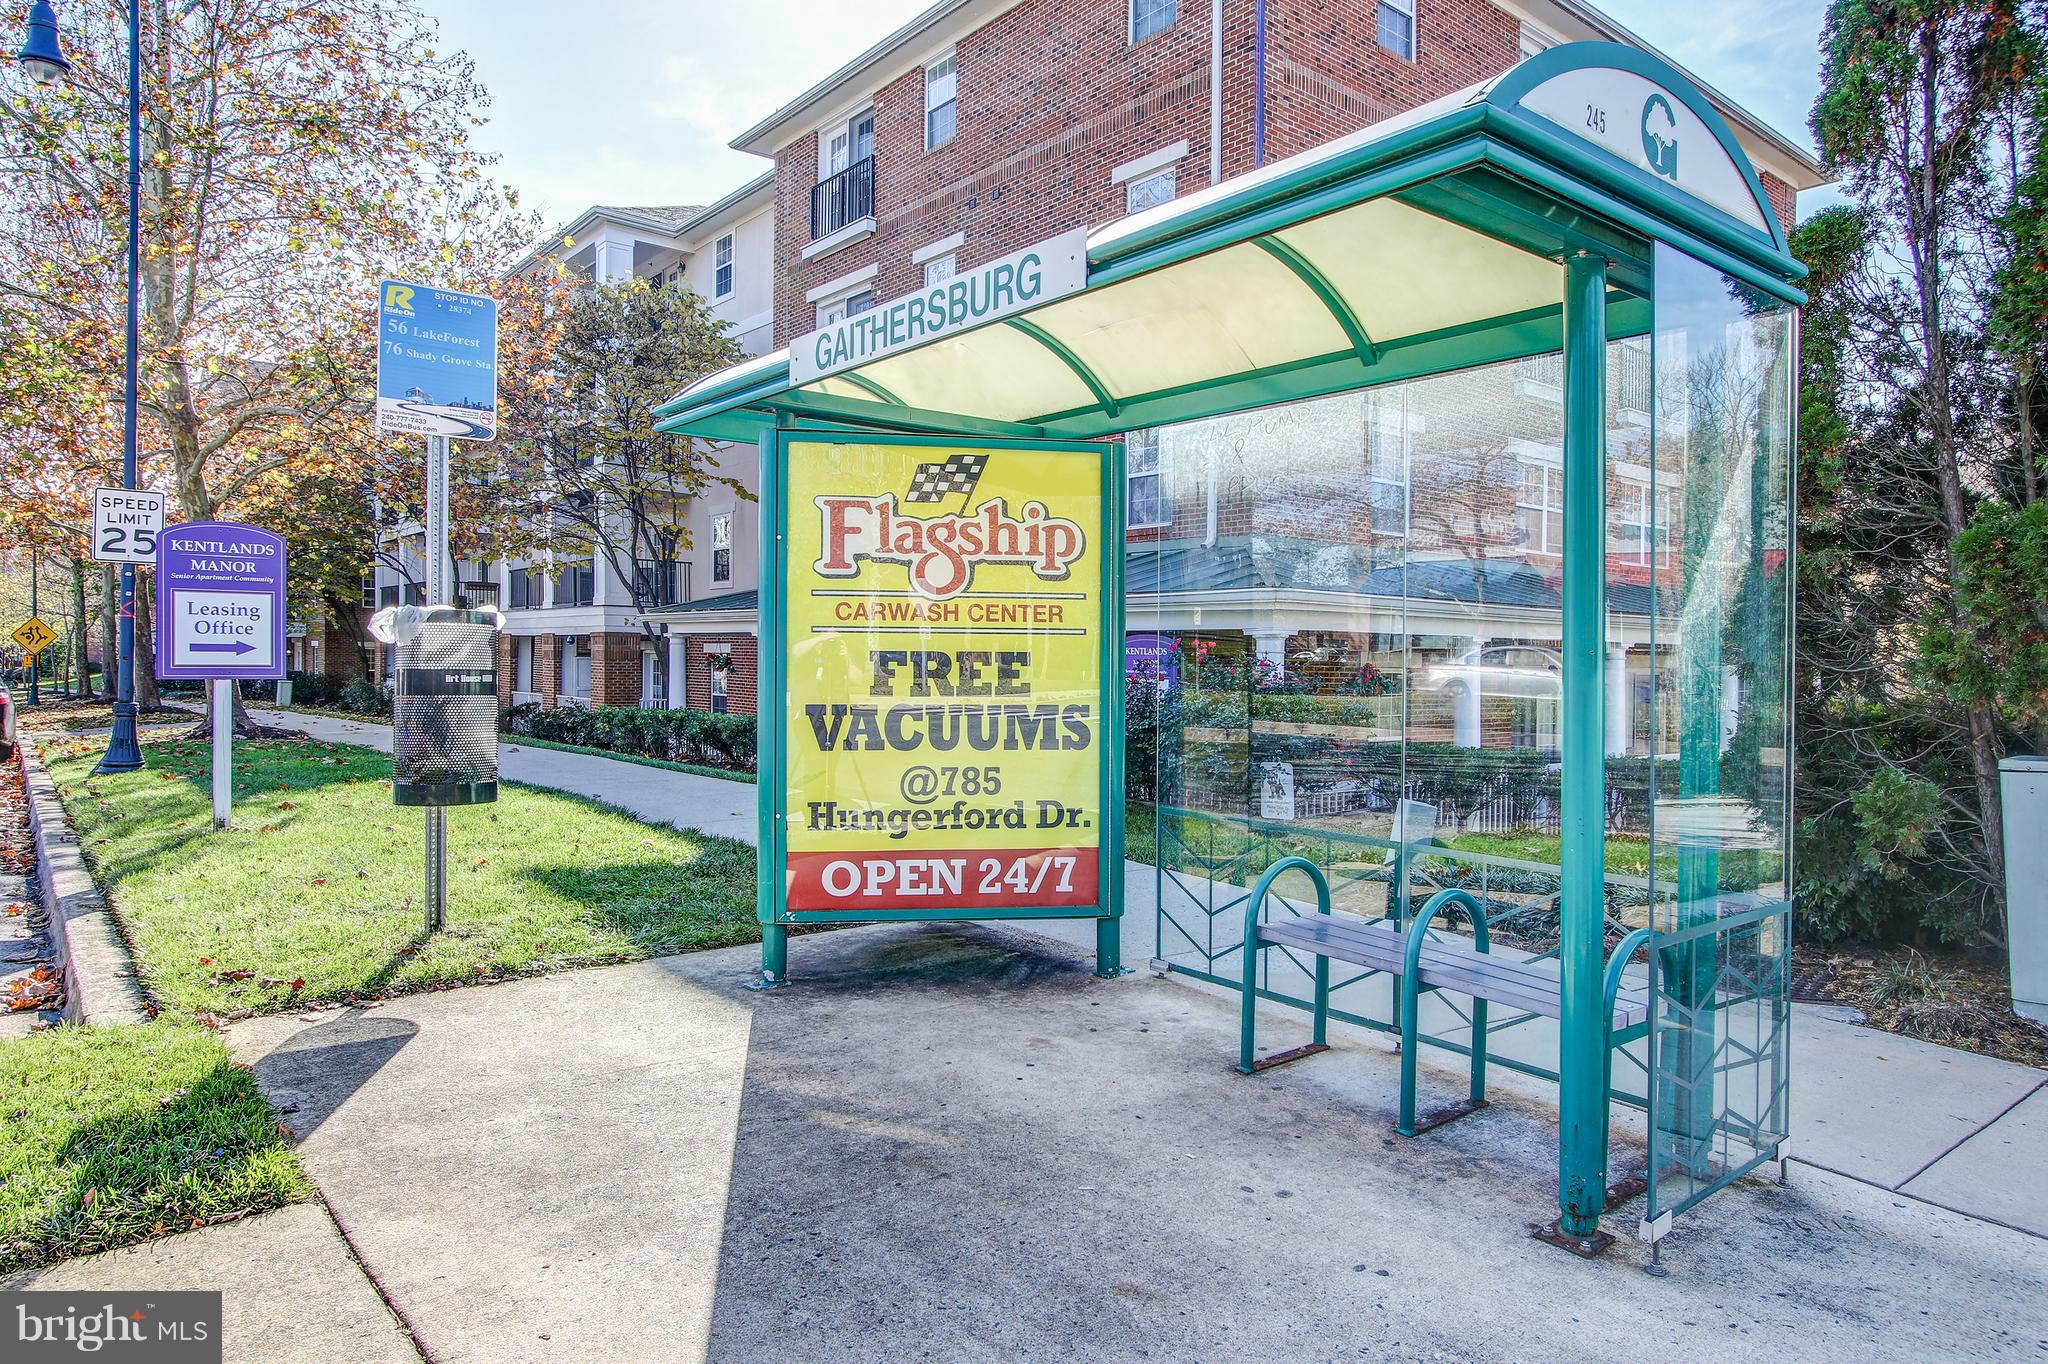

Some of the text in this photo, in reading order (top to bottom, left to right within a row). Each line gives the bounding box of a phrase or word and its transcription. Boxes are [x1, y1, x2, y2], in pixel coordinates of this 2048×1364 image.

[1586, 104, 1606, 134] 245
[434, 292, 486, 308] STOP ID NO.
[448, 304, 472, 315] 28374
[815, 253, 1042, 371] GAITHERSBURG
[387, 318, 480, 348] 56 LakeForest
[384, 340, 494, 370] 76 Shady Grove Sta.
[381, 414, 427, 425] 240-777-7433
[381, 421, 438, 432] RideOnBus.com
[101, 497, 159, 511] SPEED
[107, 512, 151, 525] LIMIT
[101, 527, 156, 555] 25
[171, 539, 275, 556] KENTLANDS
[820, 495, 1080, 597] Flagship
[190, 559, 257, 573] MANOR
[195, 573, 233, 582] Apartment
[234, 574, 275, 584] Community
[187, 601, 261, 622] Leasing
[834, 601, 1064, 624] CARWASH CENTER
[194, 620, 254, 635] Office
[1125, 647, 1168, 656] KENTLANDS
[869, 650, 1031, 698] FREE
[805, 703, 1092, 752] VACUUMS
[900, 765, 1002, 805] @785
[807, 799, 1091, 839] Hungerford Dr.
[820, 856, 1078, 897] OPEN 24/7
